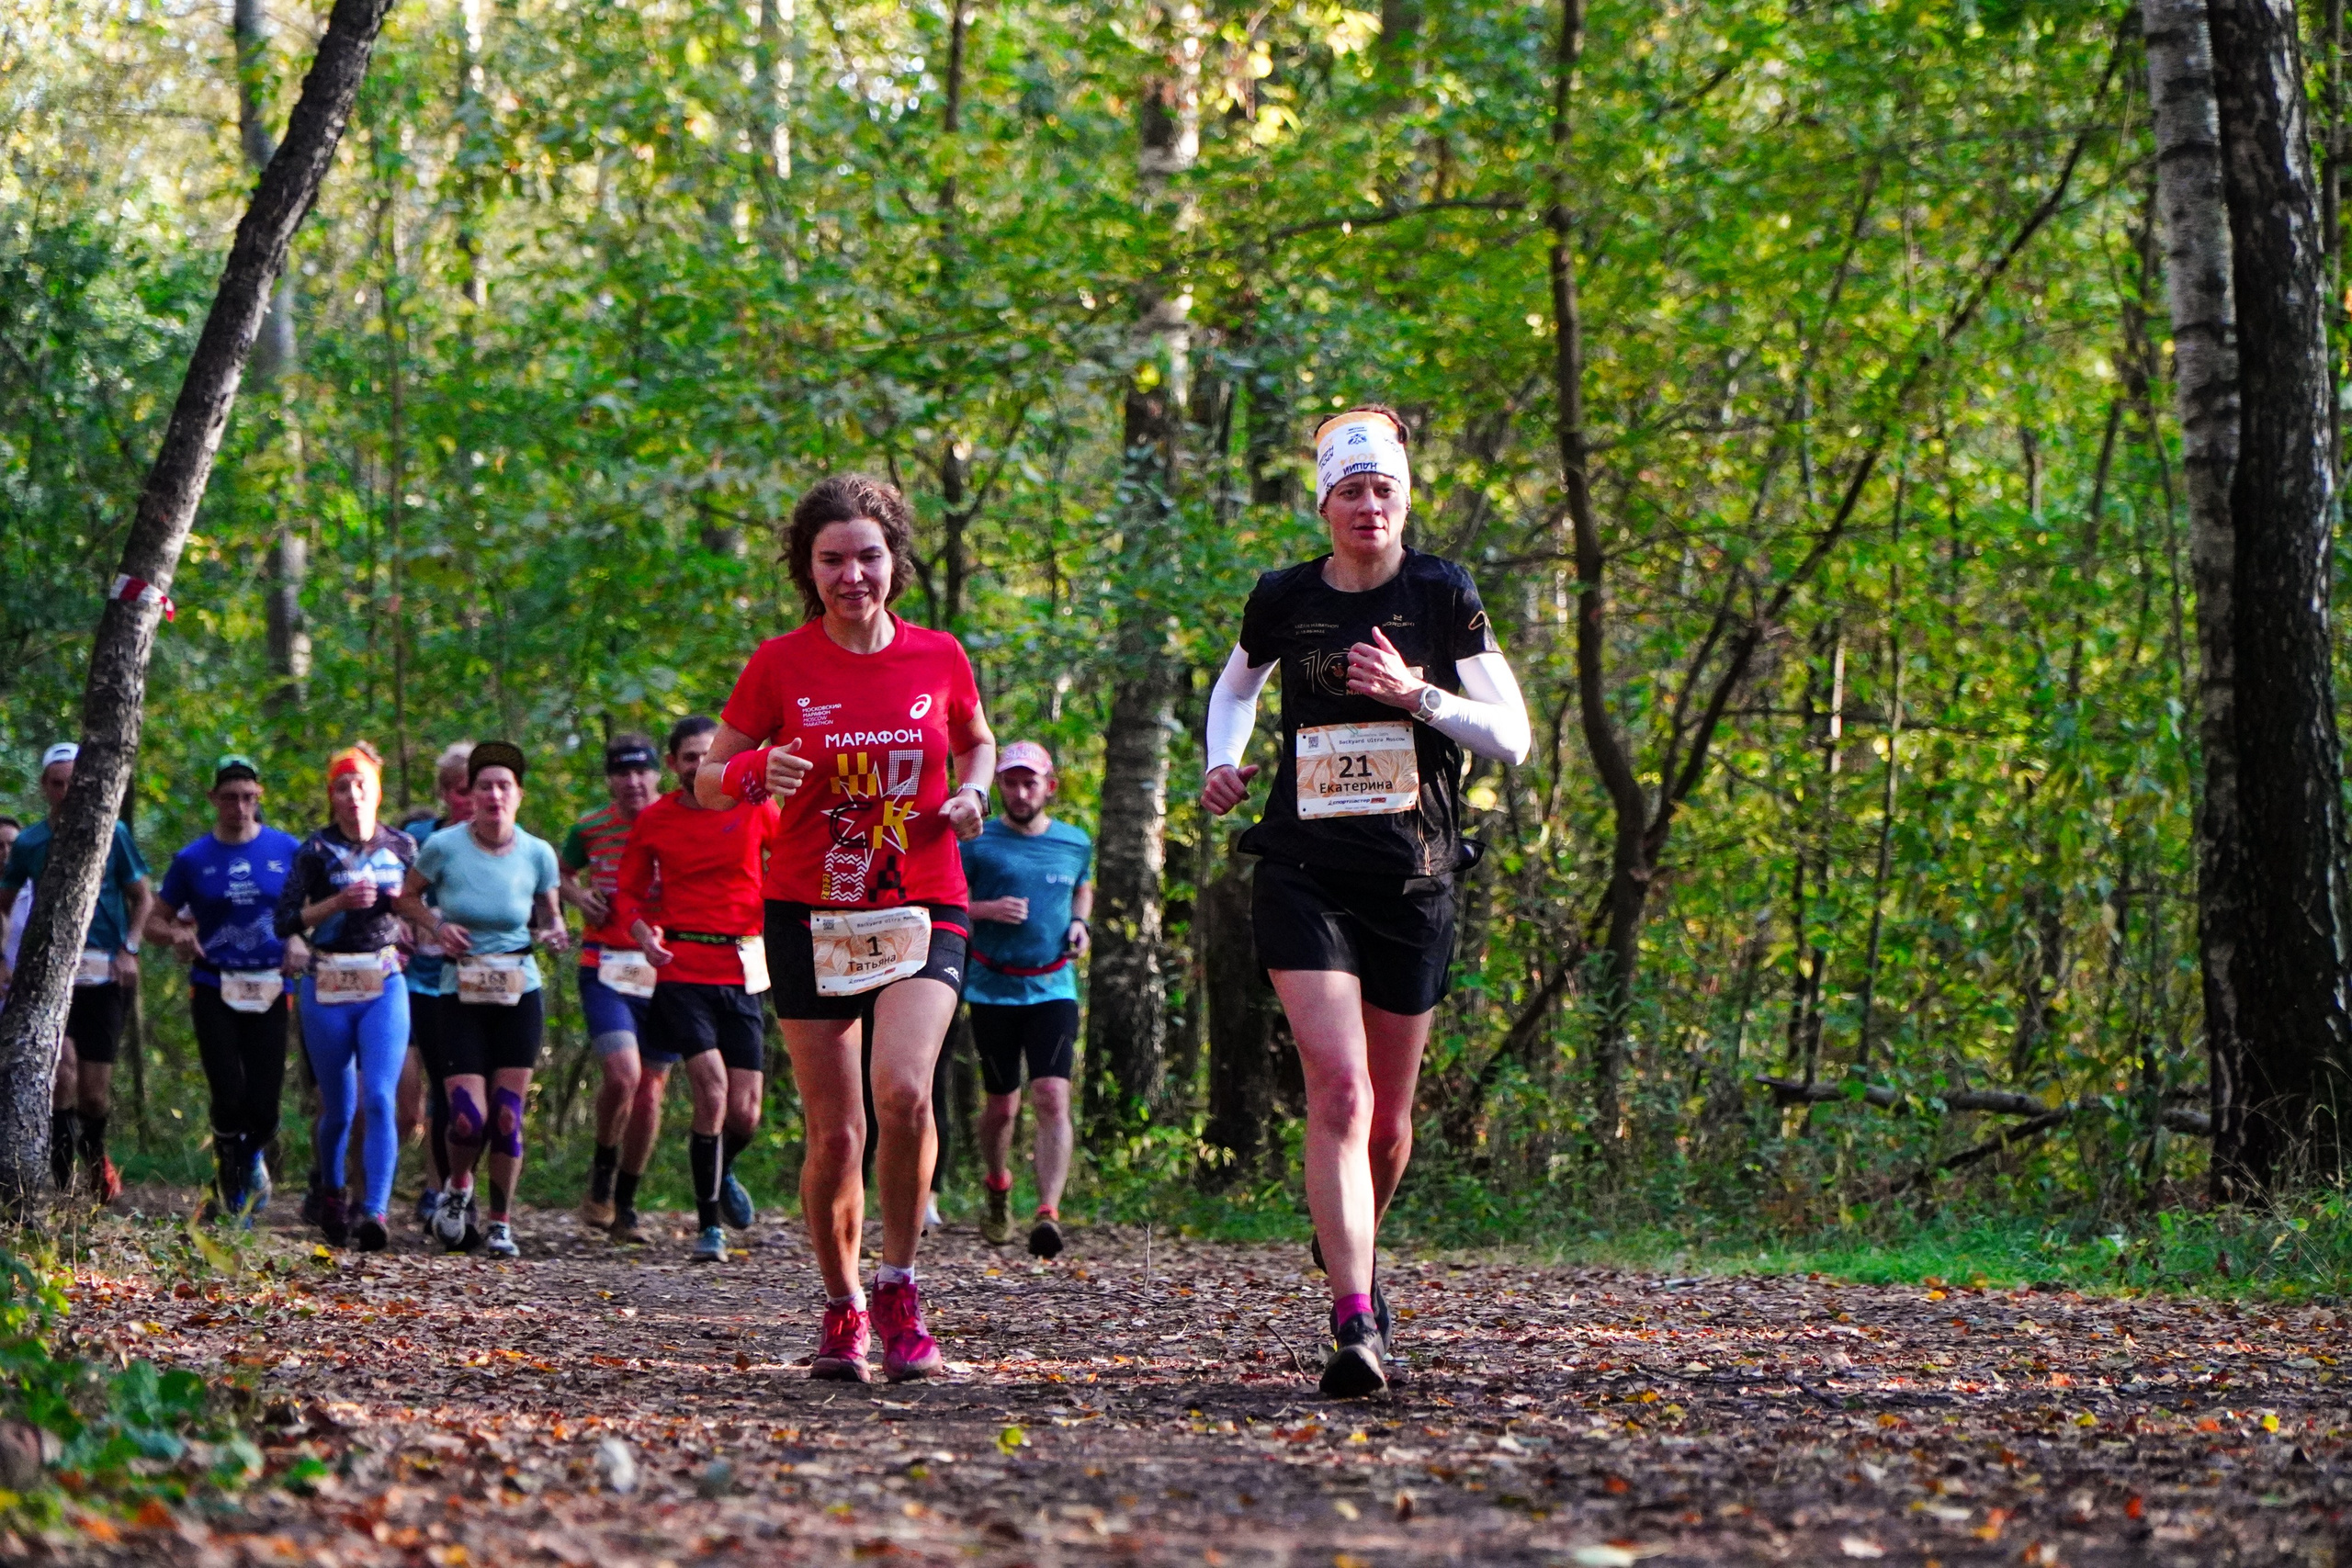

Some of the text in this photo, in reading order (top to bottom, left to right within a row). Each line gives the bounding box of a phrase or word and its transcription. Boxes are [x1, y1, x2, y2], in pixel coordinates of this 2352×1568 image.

[1342, 462, 1377, 476] НАЦИИ
[825, 728, 922, 749] МАРАФОН
[1339, 755, 1372, 778] 21
[1319, 780, 1394, 794] Екатерина
[821, 874, 831, 900] 2022
[866, 936, 882, 956] 1
[847, 954, 896, 972] Татьяна
